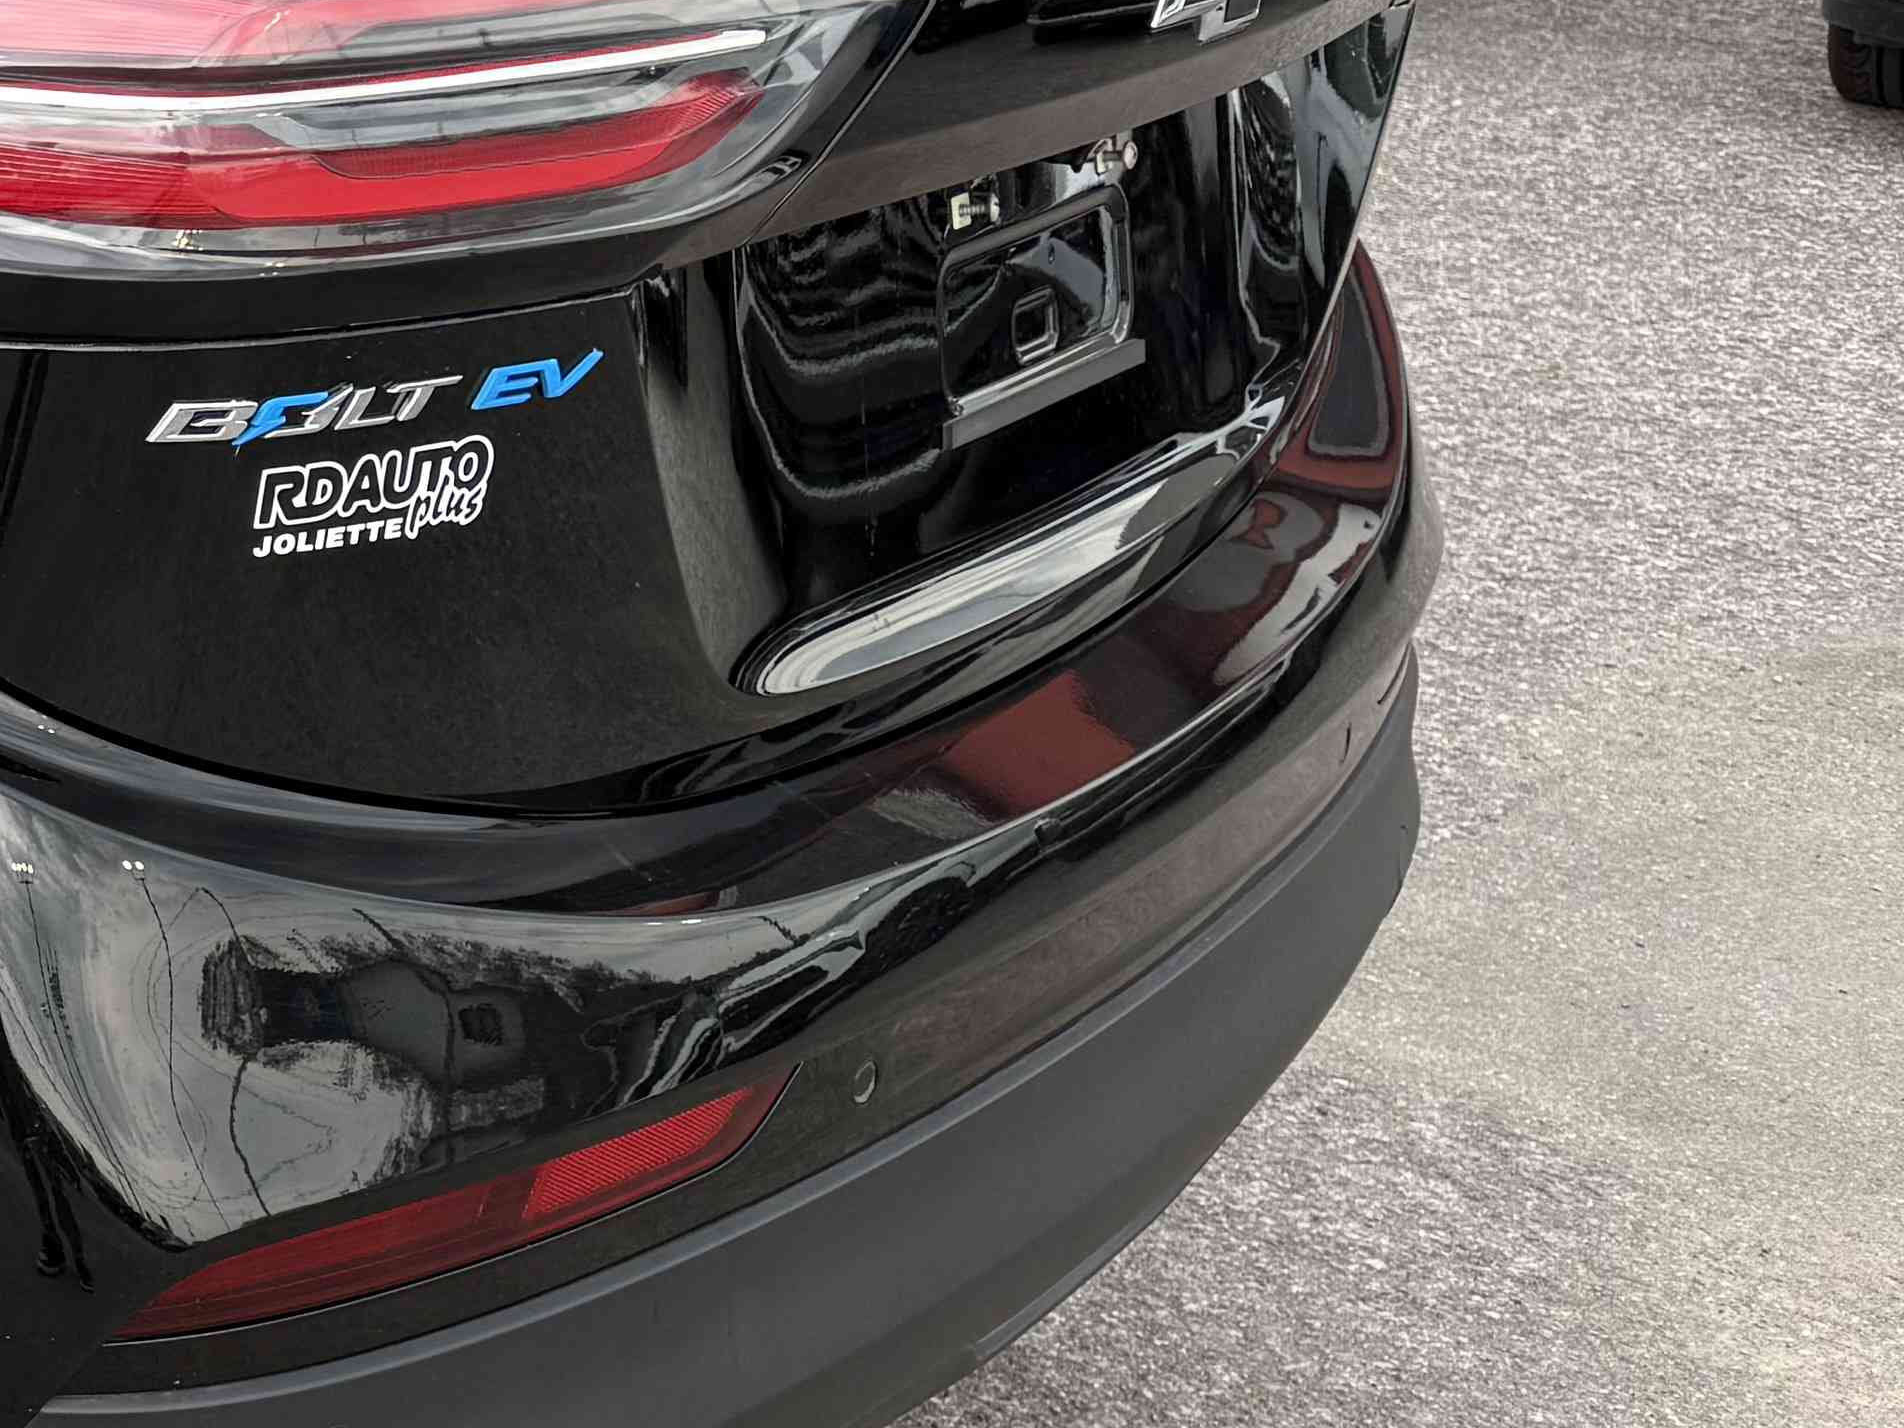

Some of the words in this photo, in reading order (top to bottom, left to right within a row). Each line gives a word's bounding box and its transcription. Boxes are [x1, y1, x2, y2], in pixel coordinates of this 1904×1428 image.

[145, 375, 463, 446] BOLT
[471, 348, 604, 410] EV
[253, 518, 403, 557] JOLIETTE
[403, 472, 489, 539] plus
